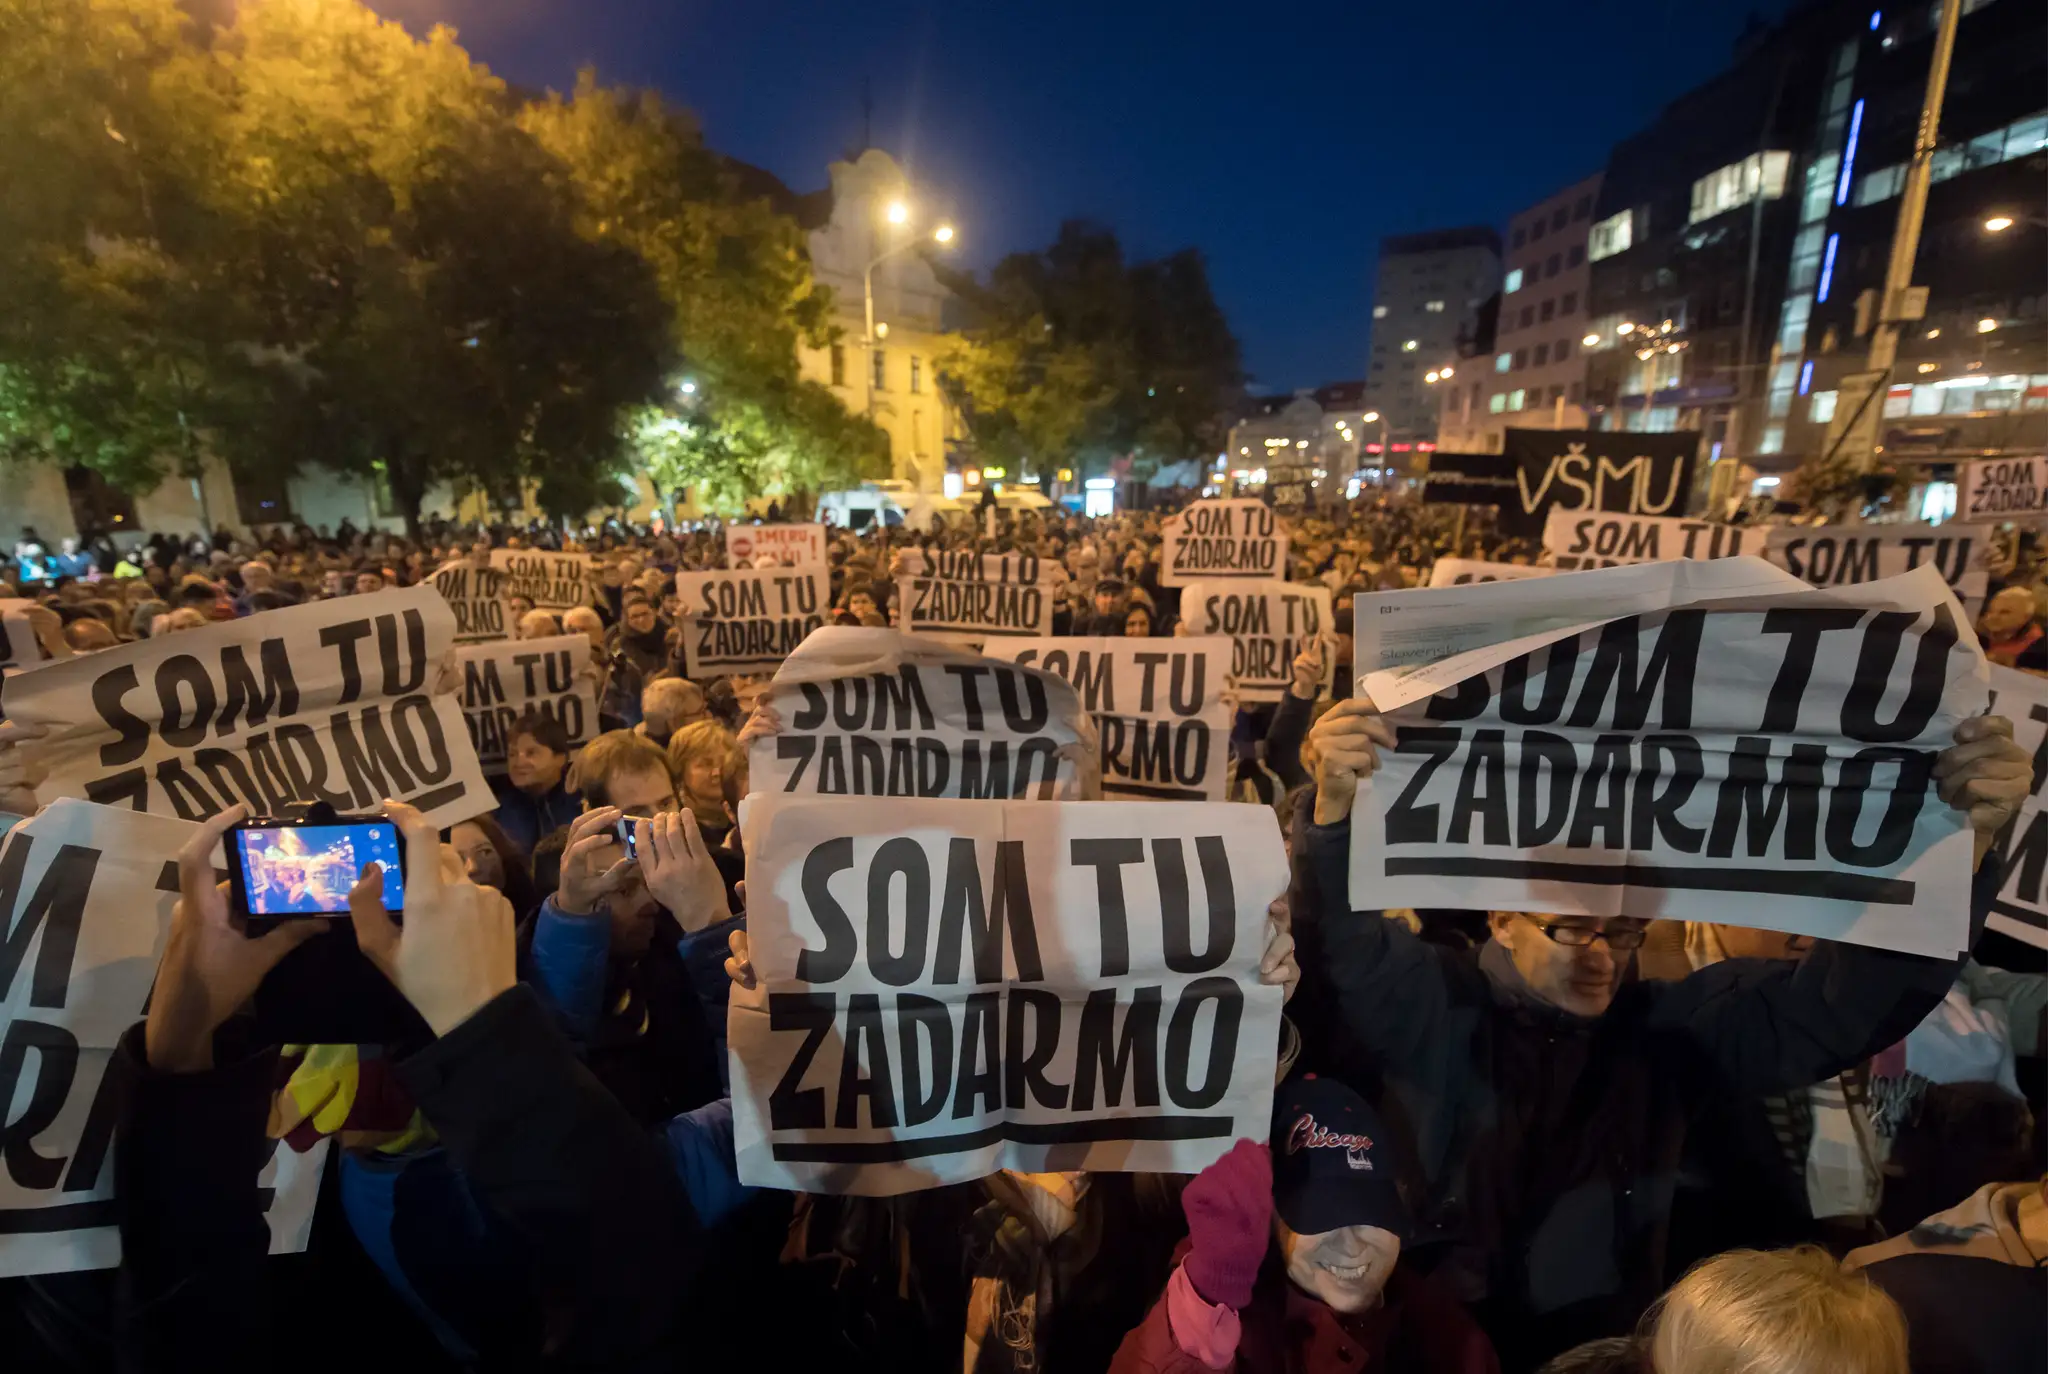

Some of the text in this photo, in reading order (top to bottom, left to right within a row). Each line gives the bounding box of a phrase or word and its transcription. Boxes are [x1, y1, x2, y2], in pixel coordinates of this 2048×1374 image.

[1517, 443, 1683, 514] VŠMU
[1982, 462, 2034, 487] SOM
[1183, 507, 1274, 537] SOM TU
[1569, 519, 1744, 561] SOM TU
[506, 555, 582, 580] SOM TU
[1173, 538, 1277, 569] ZADARMO
[1785, 537, 1974, 586] SOM TU
[451, 599, 505, 634] RMO
[702, 575, 817, 618] SOM TU
[911, 580, 1042, 629] ZADARMO
[1205, 594, 1321, 635] SOM TU
[91, 608, 428, 767] SOM TU
[513, 651, 573, 697] TU
[1133, 652, 1206, 717] TU
[1759, 607, 1959, 744] TU
[943, 664, 1049, 734] TU
[1092, 714, 1210, 787] RMO
[1384, 725, 1940, 868] ZADARMO
[795, 835, 1236, 986] SOM TU
[768, 976, 1245, 1130] ZADARMO
[1286, 1113, 1374, 1155] Chicago
